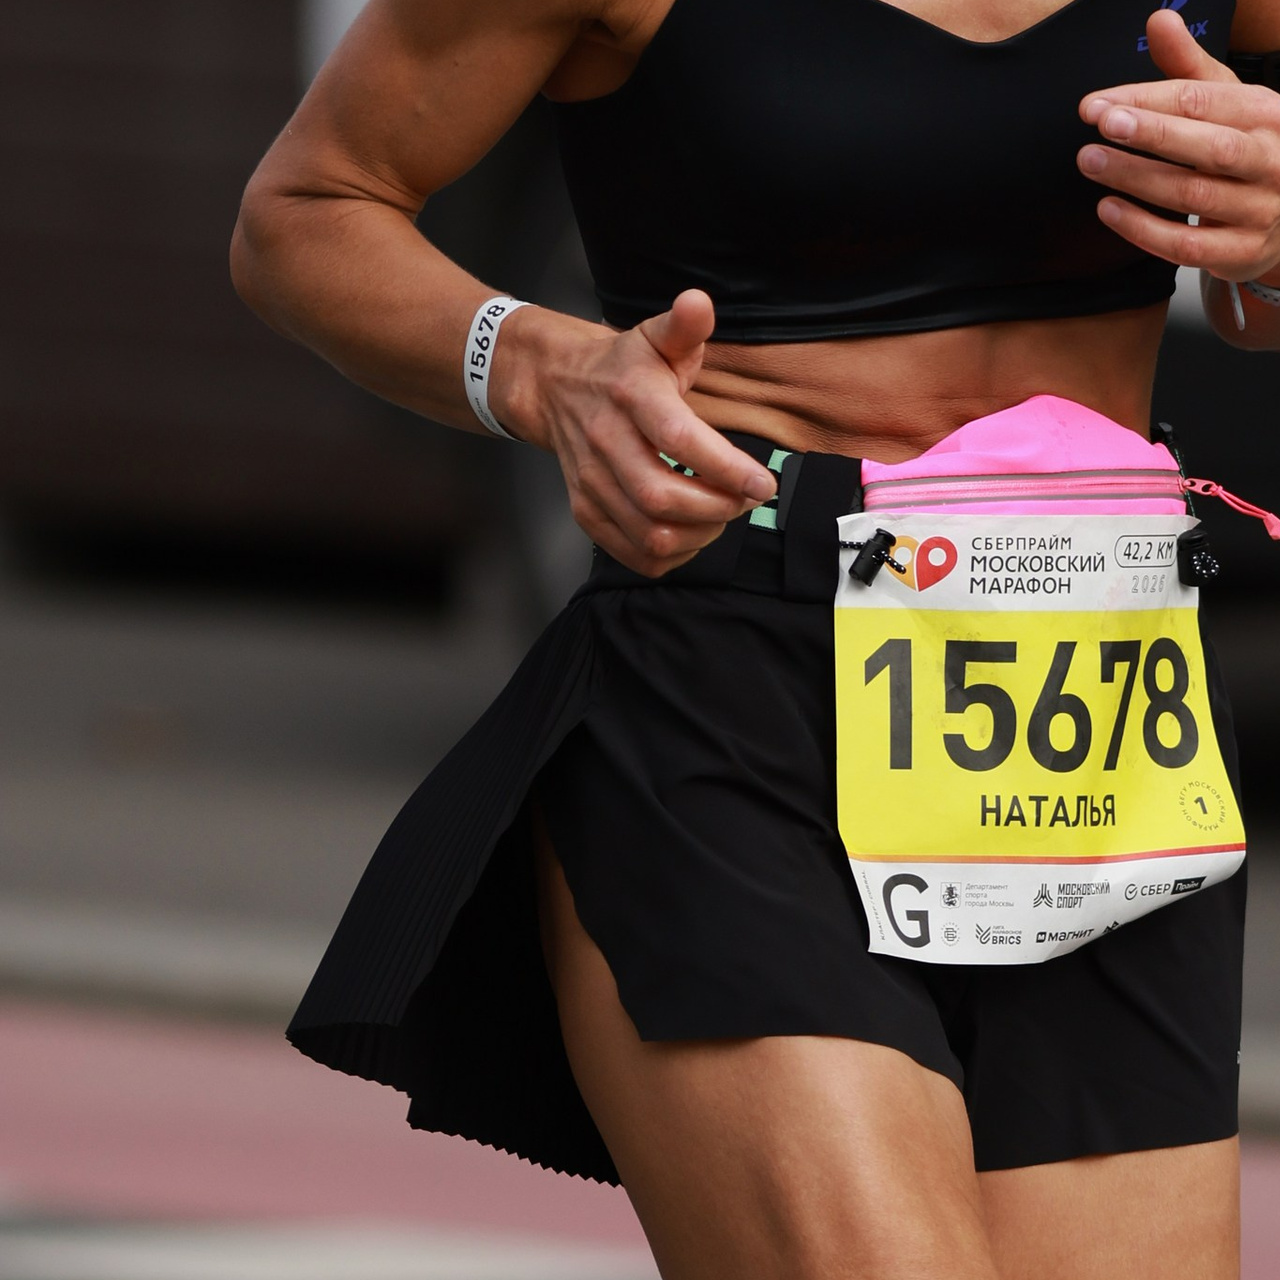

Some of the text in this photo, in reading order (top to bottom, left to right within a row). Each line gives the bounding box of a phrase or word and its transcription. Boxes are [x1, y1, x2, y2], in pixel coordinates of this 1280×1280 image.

[469, 304, 506, 383] 15678
[971, 534, 1073, 551] СБЕРПРАЙМ
[1122, 541, 1175, 563] 42,2 КМ
[970, 551, 1105, 573] МОСКОВСКИЙ
[969, 576, 1072, 595] МАРАФОН
[864, 636, 1200, 773] 15678
[980, 794, 1117, 828] НАТАЛЬЯ
[1193, 796, 1208, 815] 1
[965, 883, 1008, 891] Департамент
[1057, 878, 1111, 896] МОСКОВСКИЙ
[1140, 883, 1171, 896] СБЕР
[882, 873, 931, 949] G
[1056, 896, 1084, 909] СПОРТ
[991, 935, 1022, 945] BRICS
